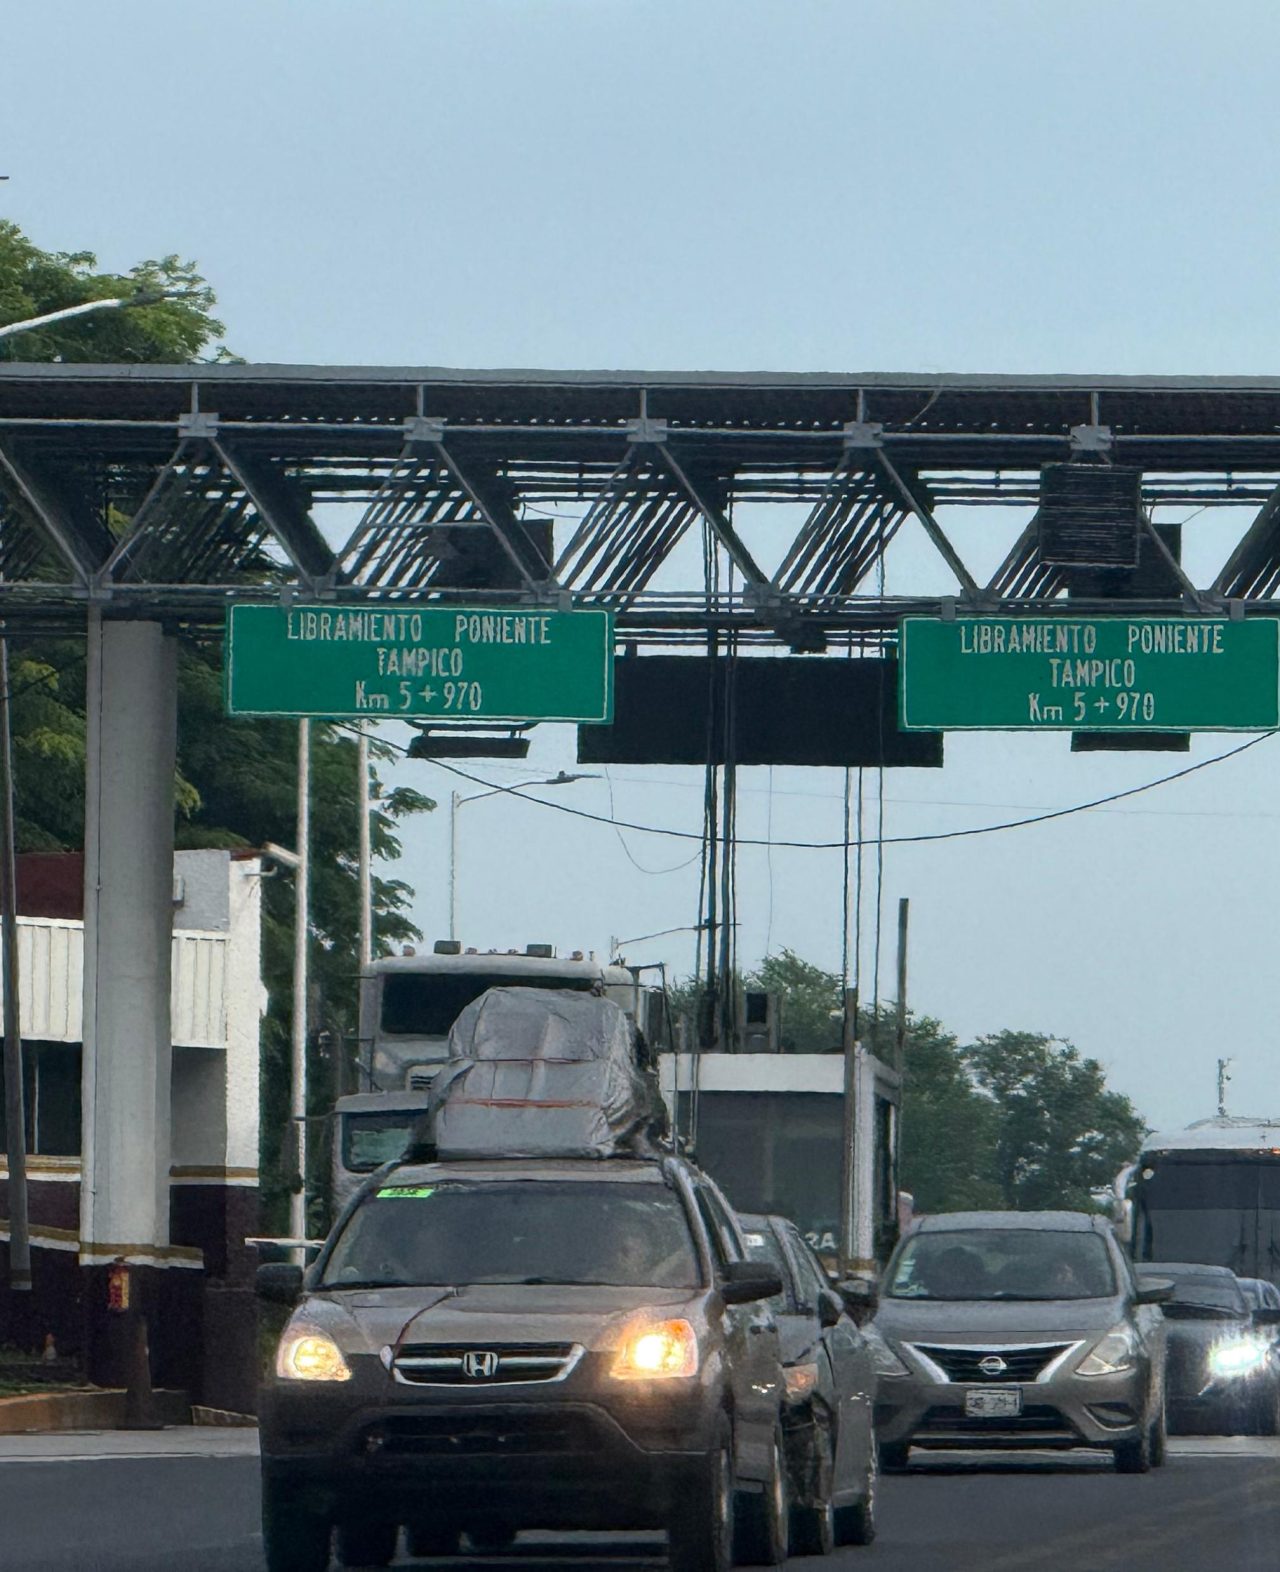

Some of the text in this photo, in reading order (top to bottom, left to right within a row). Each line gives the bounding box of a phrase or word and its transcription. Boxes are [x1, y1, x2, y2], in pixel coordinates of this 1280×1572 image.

[287, 611, 552, 644] LIBRAMIENTO PONIENTE
[960, 624, 1225, 654] LIBRAMIENTO PONIENTE
[376, 647, 463, 677] TAMPICO
[1049, 658, 1135, 688] TAMPICO
[355, 680, 389, 709] Km
[1028, 692, 1063, 722] Km
